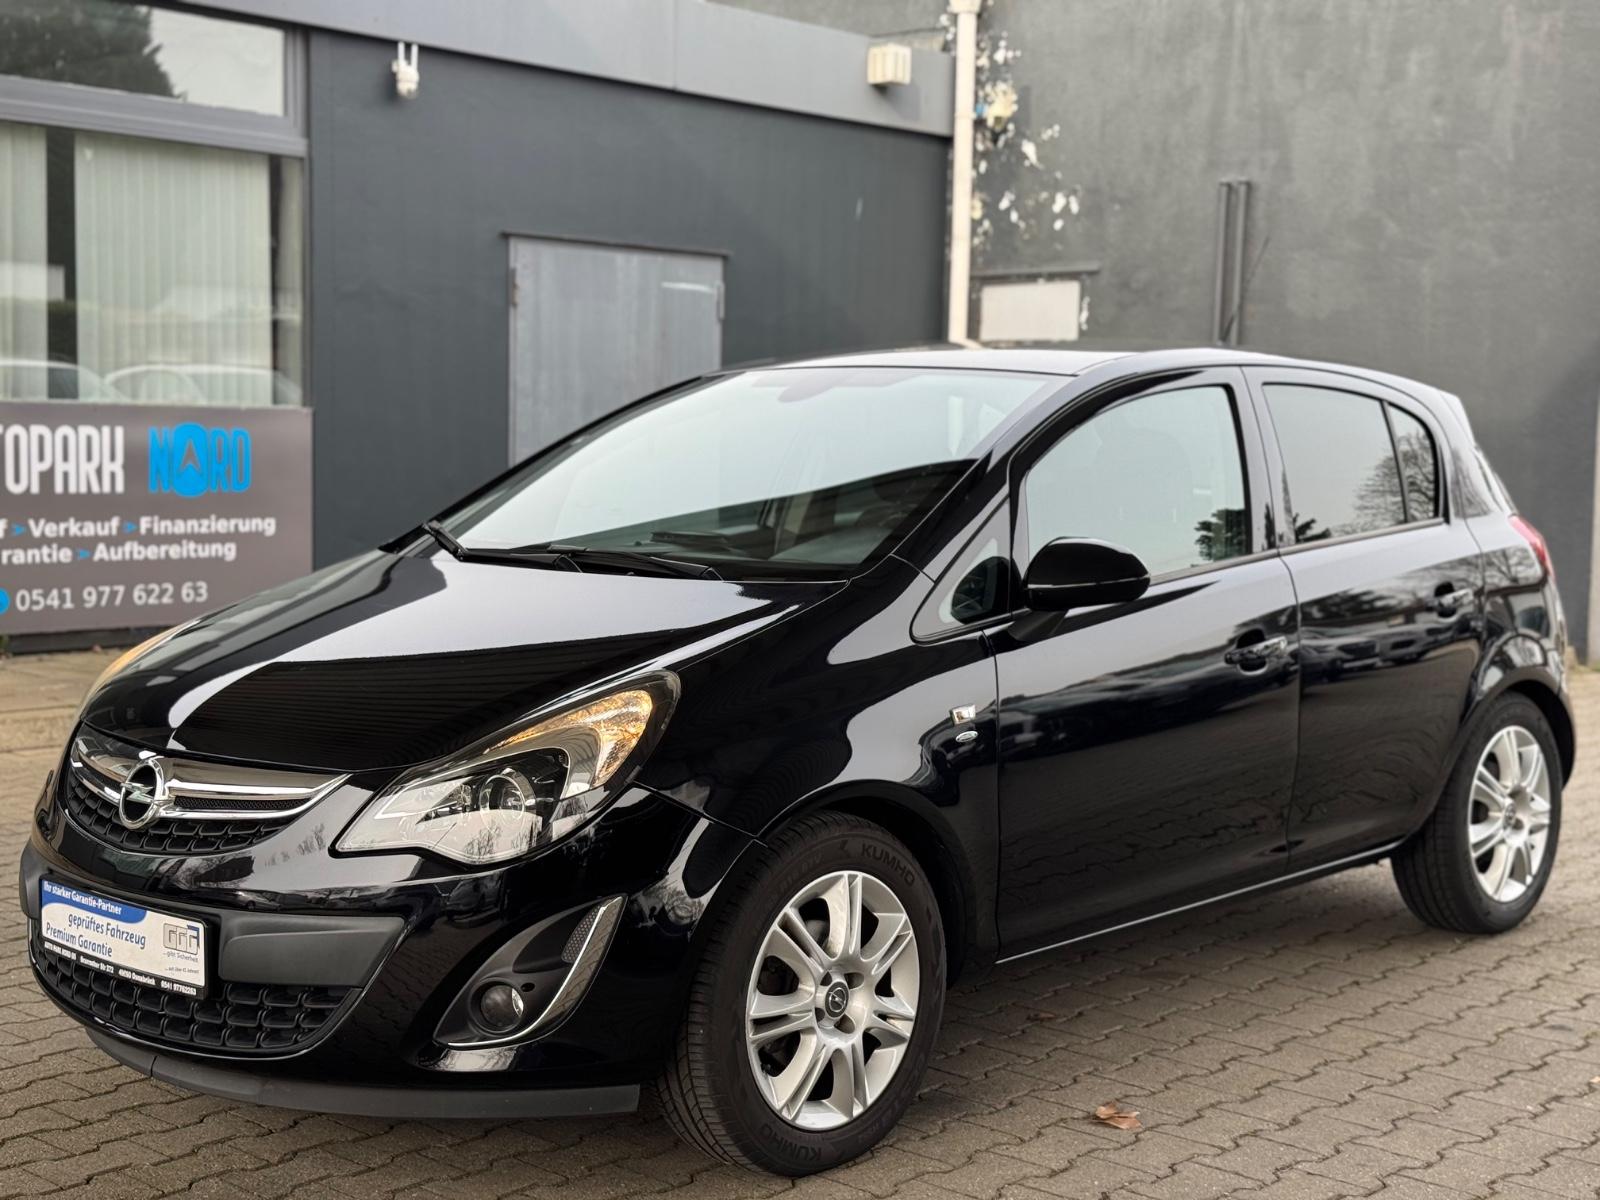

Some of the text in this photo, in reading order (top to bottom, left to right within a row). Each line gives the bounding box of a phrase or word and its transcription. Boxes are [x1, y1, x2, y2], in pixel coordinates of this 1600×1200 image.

[0, 422, 252, 497] OPARK NORD
[28, 516, 120, 538] Verkauf
[139, 514, 276, 536] Finanzierung
[93, 540, 237, 561] Aufbereitung
[15, 581, 208, 611] 0541 977 622 63
[860, 842, 915, 886] KUMHO
[71, 890, 122, 915] Garantie-Partner
[46, 921, 77, 946] Premium
[78, 934, 113, 958] Garantie
[68, 913, 146, 950] geprüftes Fahrzeug
